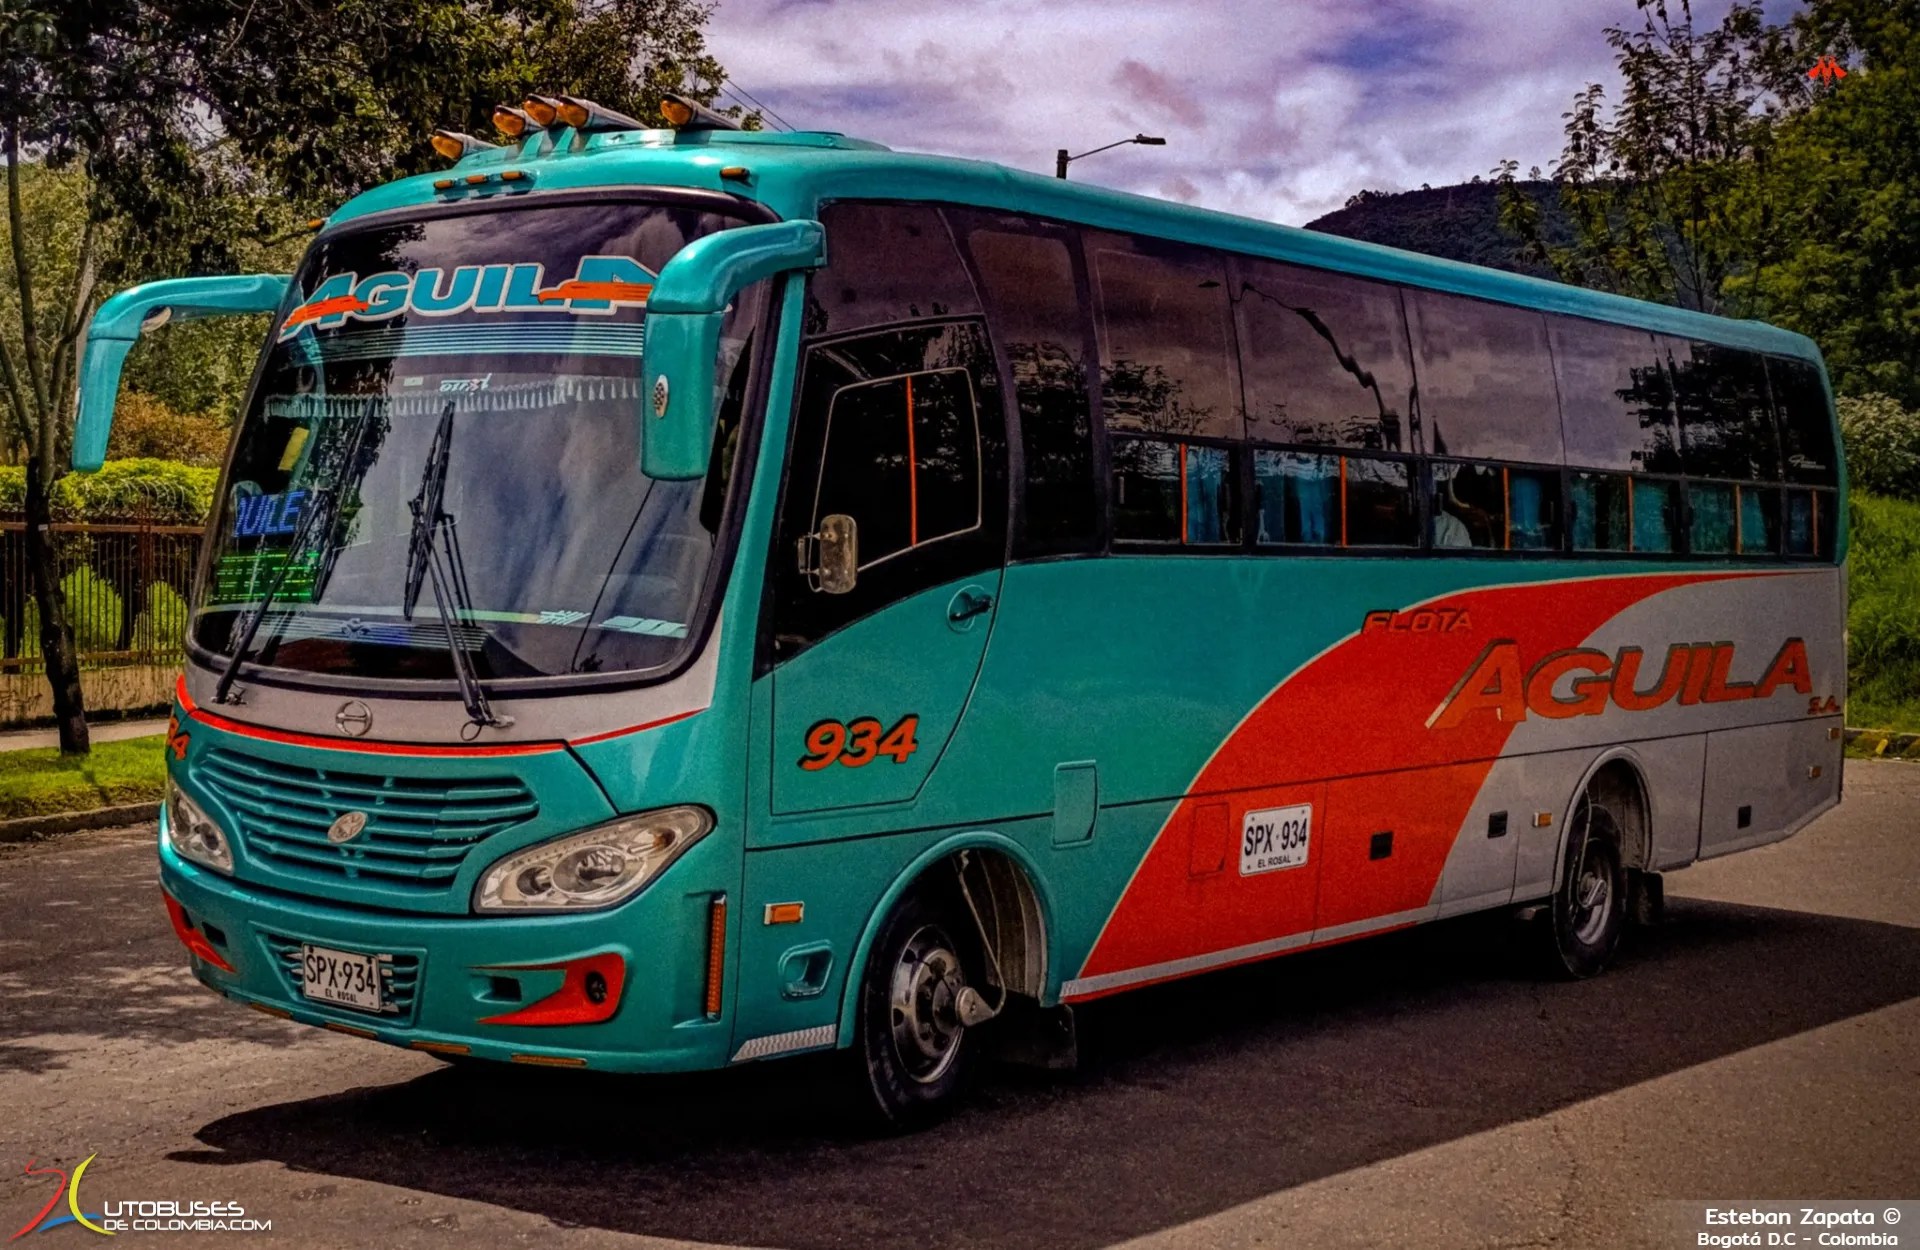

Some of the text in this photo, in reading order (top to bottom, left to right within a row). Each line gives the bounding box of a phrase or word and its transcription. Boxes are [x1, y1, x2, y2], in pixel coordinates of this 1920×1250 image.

[278, 255, 658, 343] AGUILA
[1360, 608, 1474, 634] FLOTA
[1424, 637, 1813, 729] AGUILA
[797, 713, 920, 772] 934
[1257, 855, 1292, 868] EL ROSAL
[325, 988, 334, 998] EL
